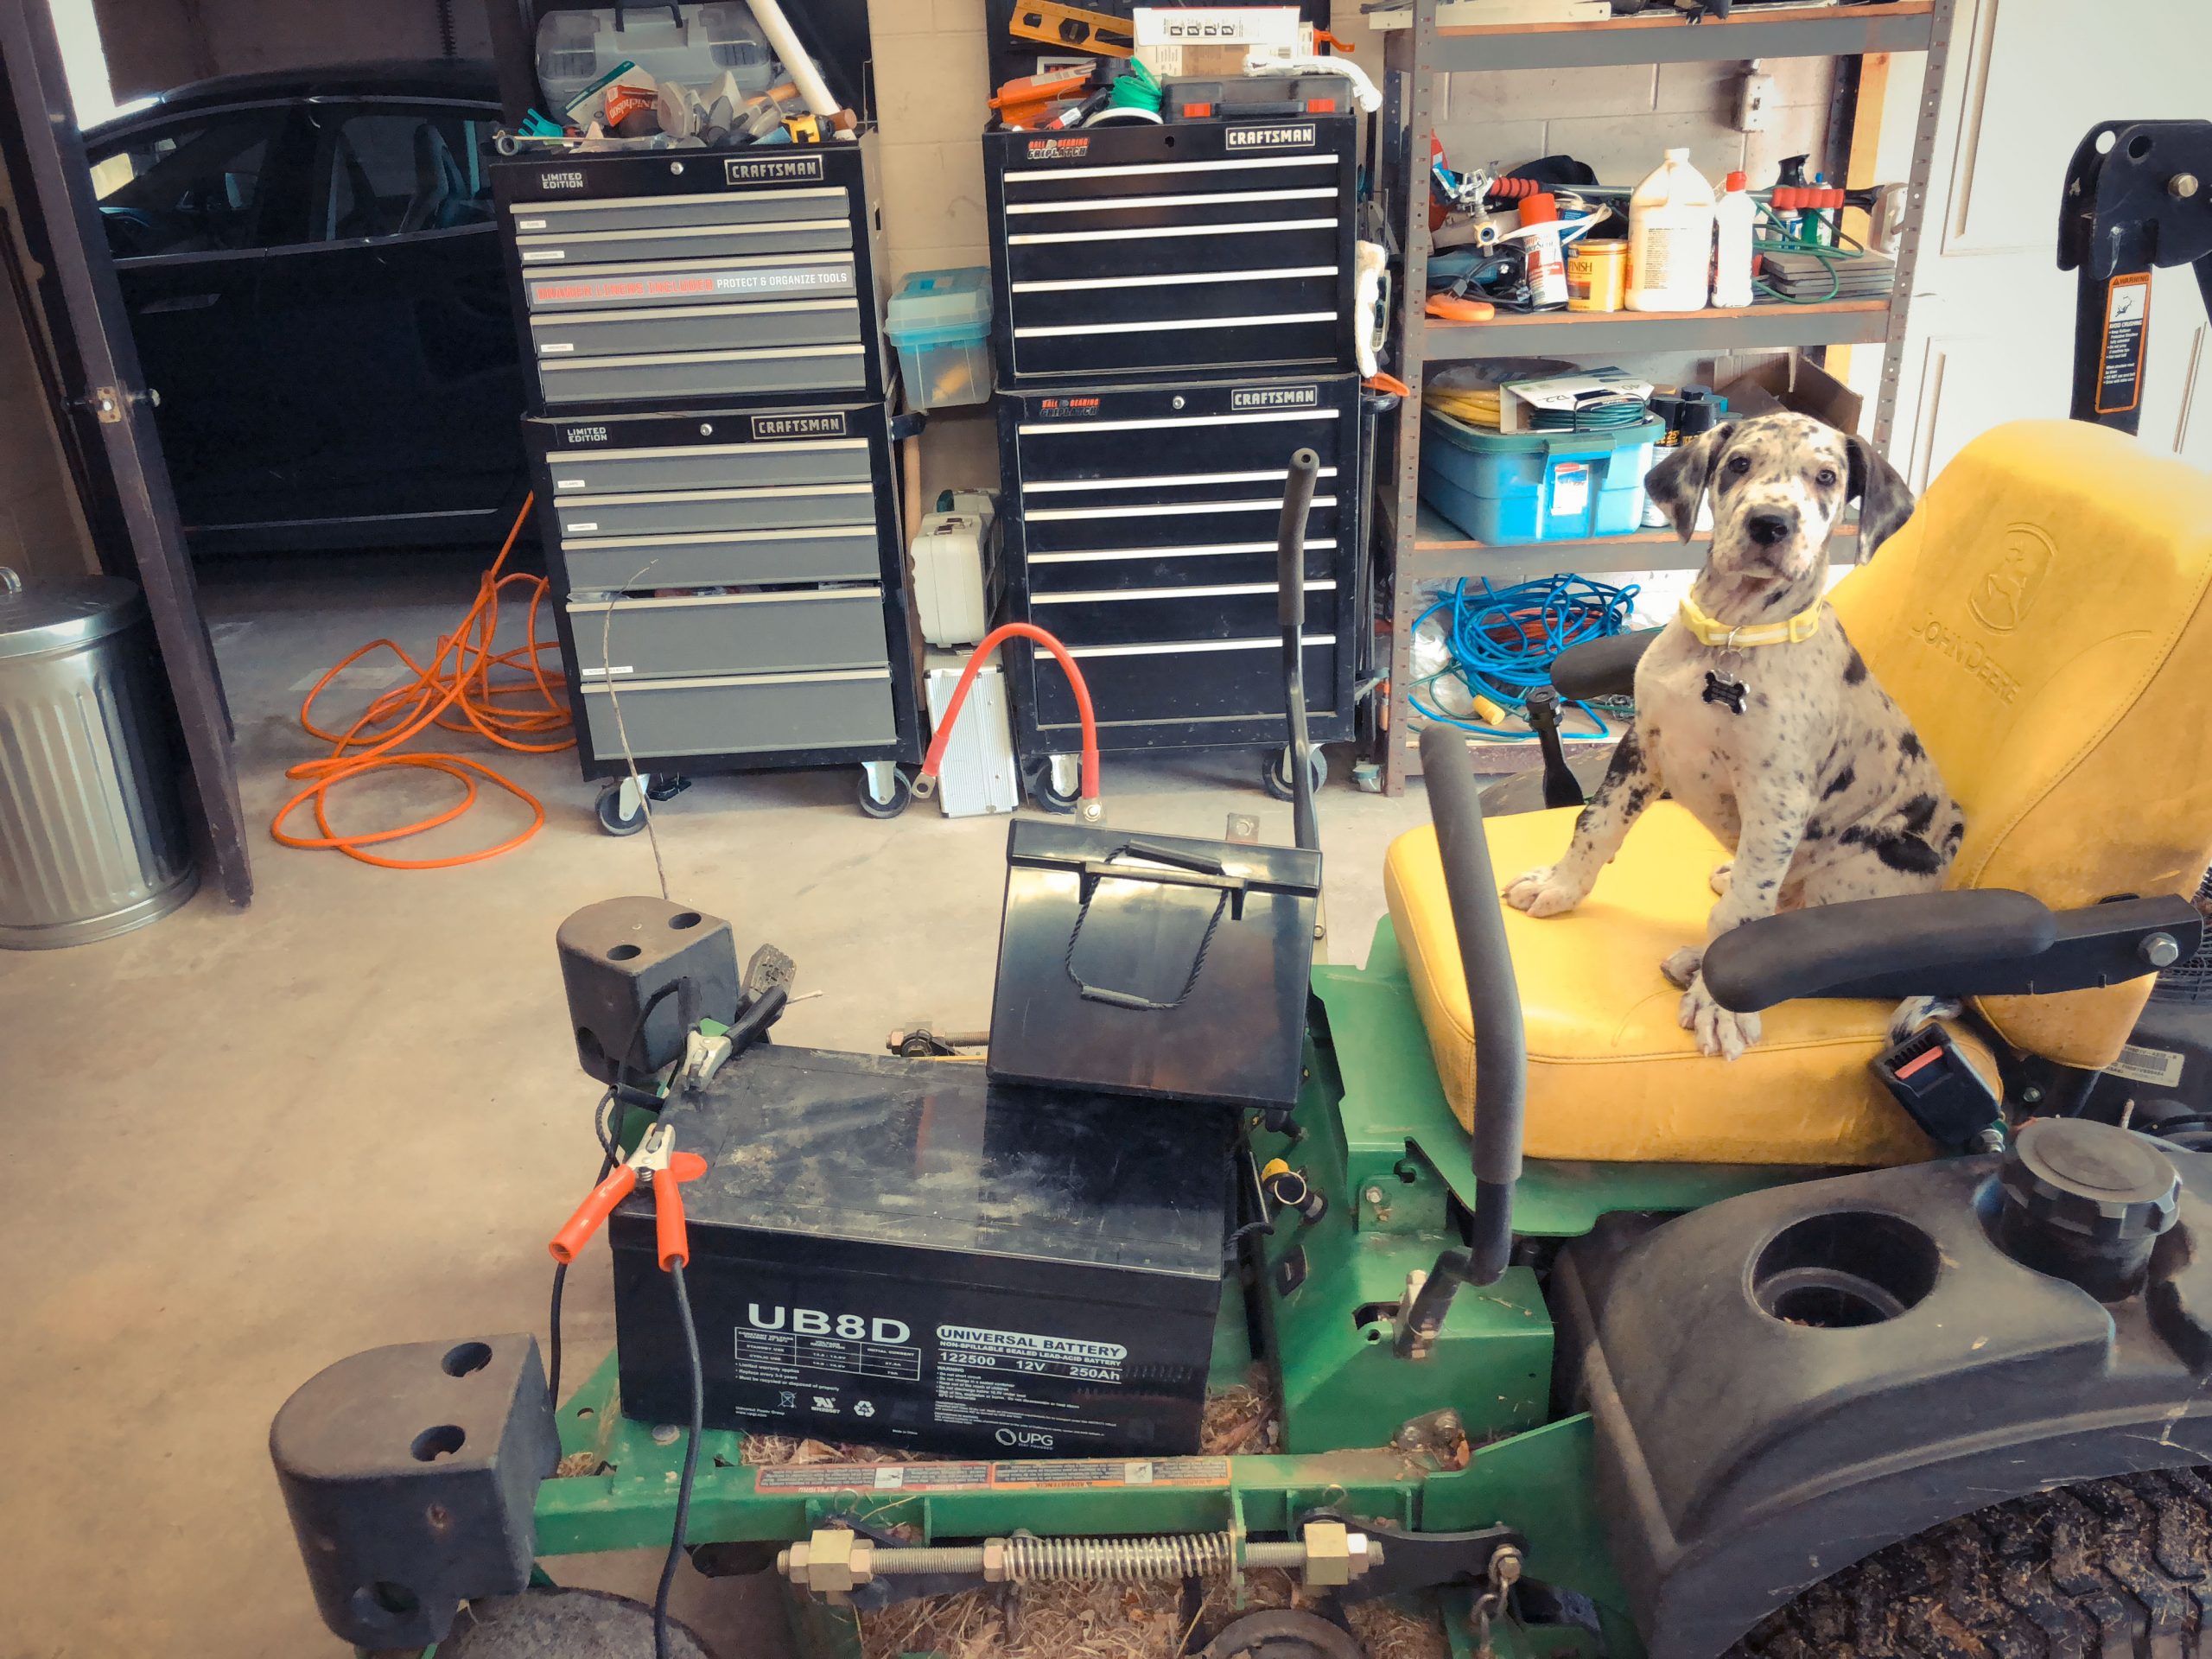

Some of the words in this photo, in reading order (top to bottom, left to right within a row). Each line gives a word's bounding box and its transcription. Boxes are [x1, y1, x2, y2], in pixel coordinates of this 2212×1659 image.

[1229, 130, 1313, 145] CRAFTSMAN
[541, 173, 582, 182] LIMITED
[732, 161, 817, 180] CRAFTSMAN
[542, 180, 584, 189] EDITION
[537, 286, 592, 301] DRAWER
[596, 283, 644, 298] LINERS
[648, 278, 714, 294] INCLUDED
[716, 276, 758, 289] PROTECT
[760, 276, 766, 286] &
[769, 275, 816, 286] ORGANIZE
[817, 272, 847, 283] TOOLS
[2120, 275, 2150, 284] WARNING
[1235, 390, 1315, 406] CRAFTSMAN
[567, 427, 607, 436] LIMITED
[759, 419, 840, 435] CRAFTSMAN
[568, 434, 607, 442] EDITION
[748, 1303, 911, 1344] UB8D
[940, 1328, 1038, 1348] UNIVERSAL
[1043, 1339, 1122, 1357] BATTERY
[939, 1340, 1004, 1353] NON-SPILLABLE
[1006, 1348, 1038, 1357] SEALED
[1039, 1351, 1082, 1363] LEAD-ACID
[1084, 1357, 1122, 1367] BATTERY
[939, 1351, 996, 1366] 122500
[1016, 1360, 1046, 1372] 12V
[1070, 1366, 1121, 1381] 250Ah
[1018, 1431, 1053, 1446] UPG
